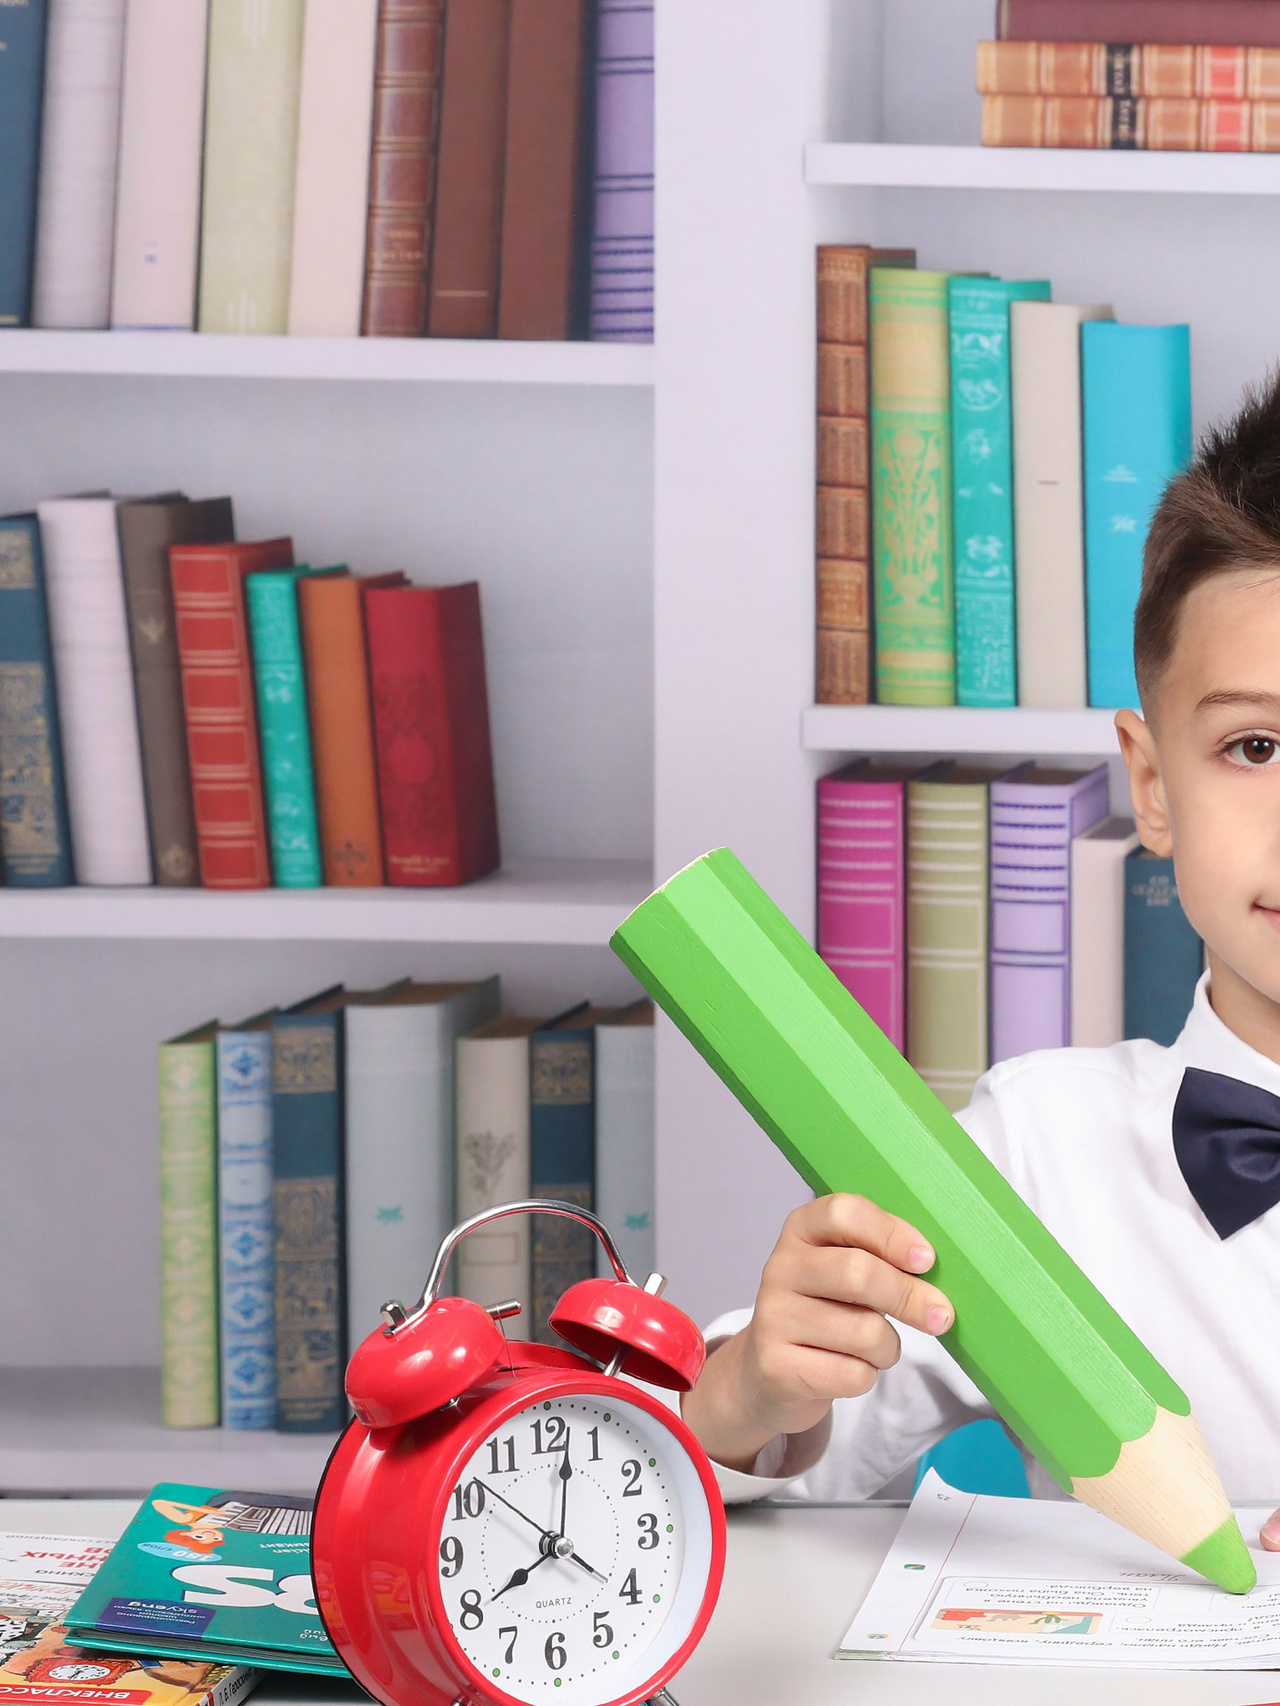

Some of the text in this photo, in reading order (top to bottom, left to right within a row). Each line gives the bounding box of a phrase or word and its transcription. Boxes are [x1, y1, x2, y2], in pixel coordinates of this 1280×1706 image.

[486, 1435, 520, 1475] 11
[529, 1416, 567, 1456] 12
[587, 1426, 603, 1462] 1
[620, 1459, 643, 1498] 2
[451, 1480, 486, 1522] 10
[637, 1512, 660, 1550] 3
[440, 1536, 464, 1578] 9
[535, 1596, 573, 1609] QUARTZ
[618, 1567, 643, 1606] 4
[127, 1601, 198, 1614] skyeng
[459, 1588, 484, 1631] 8
[498, 1626, 518, 1664] 7
[592, 1610, 614, 1648] 5
[544, 1632, 567, 1670] 6
